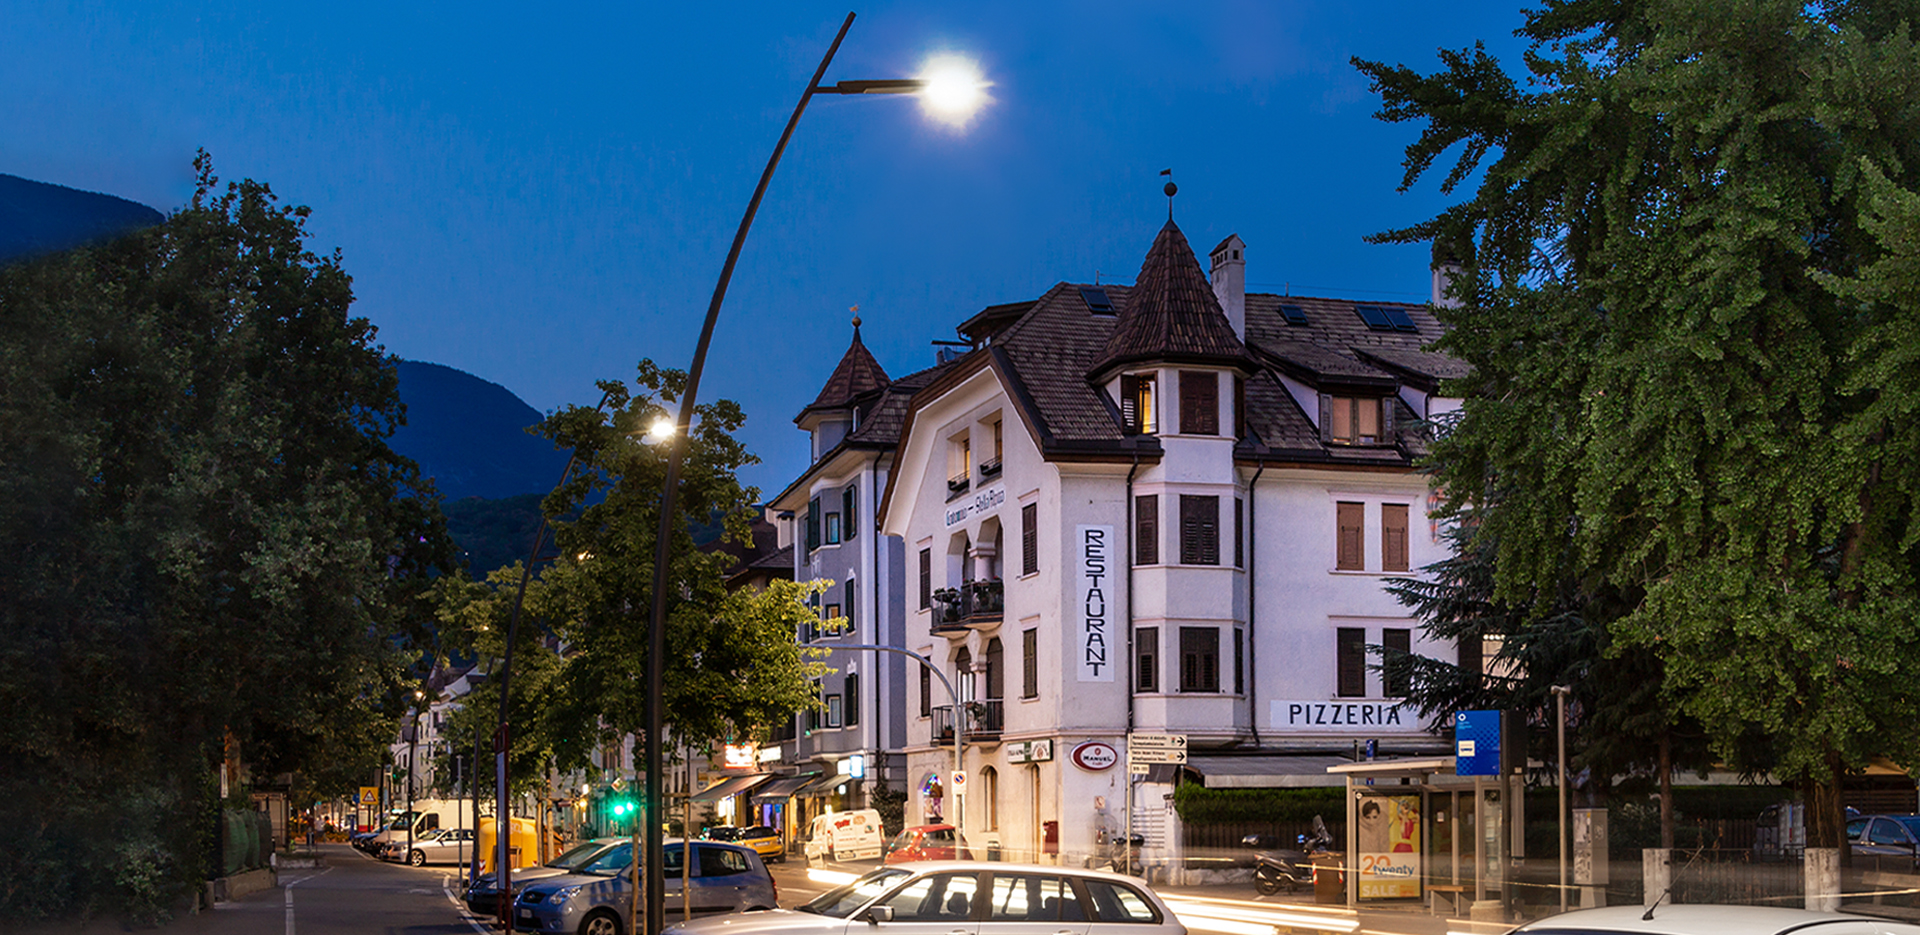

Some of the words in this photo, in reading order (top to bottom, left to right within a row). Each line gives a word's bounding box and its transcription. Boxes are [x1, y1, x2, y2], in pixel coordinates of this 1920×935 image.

[1085, 529, 1106, 677] RESTAURANT
[1289, 704, 1401, 725] PIZZERIA
[1373, 864, 1415, 877] twenty
[1362, 885, 1397, 897] SALE
